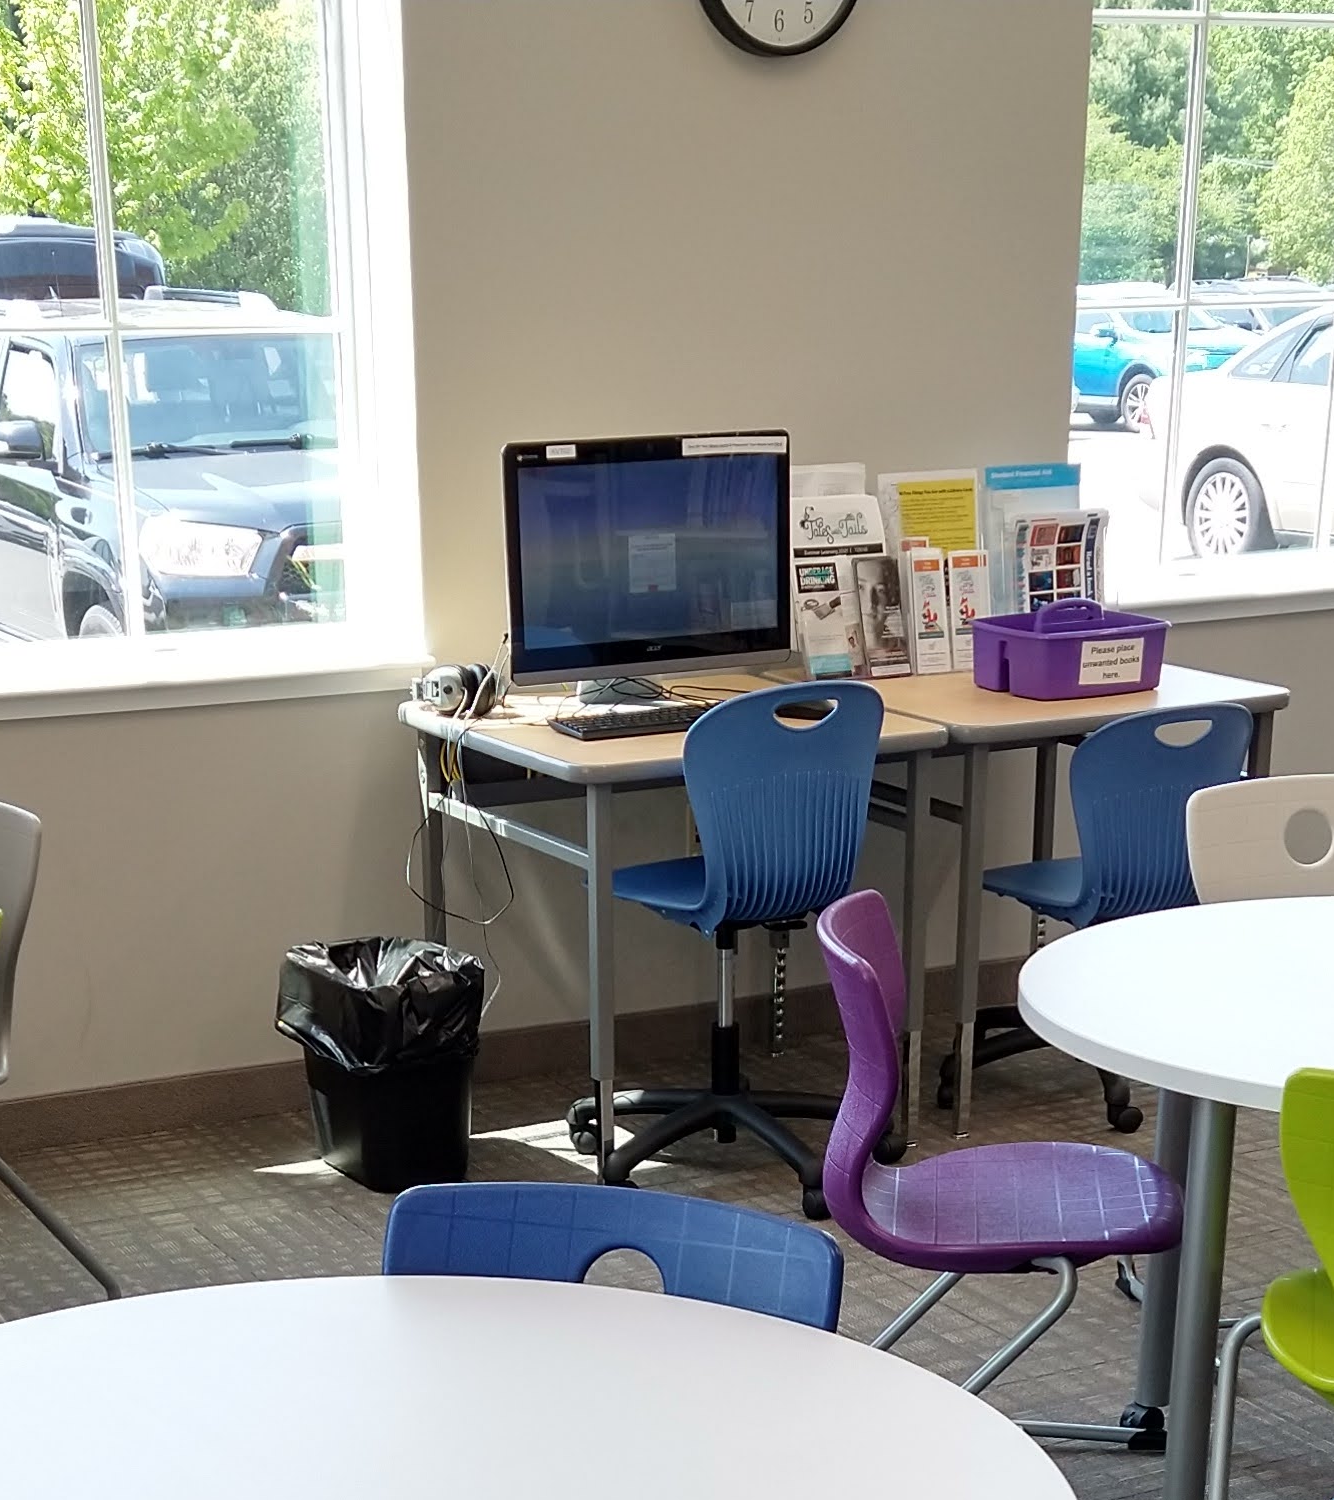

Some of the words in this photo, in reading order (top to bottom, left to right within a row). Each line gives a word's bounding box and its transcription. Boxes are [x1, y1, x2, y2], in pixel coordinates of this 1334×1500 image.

[745, 0, 754, 23] 7
[804, 1, 813, 24] 5
[774, 9, 785, 32] 6
[839, 512, 868, 538] Tails
[798, 566, 835, 577] UNDERAGE
[800, 575, 836, 586] DRINKING
[1091, 646, 1114, 655] Please
[1116, 644, 1135, 653] place
[1083, 657, 1118, 668] unwanted
[1119, 656, 1139, 665] books
